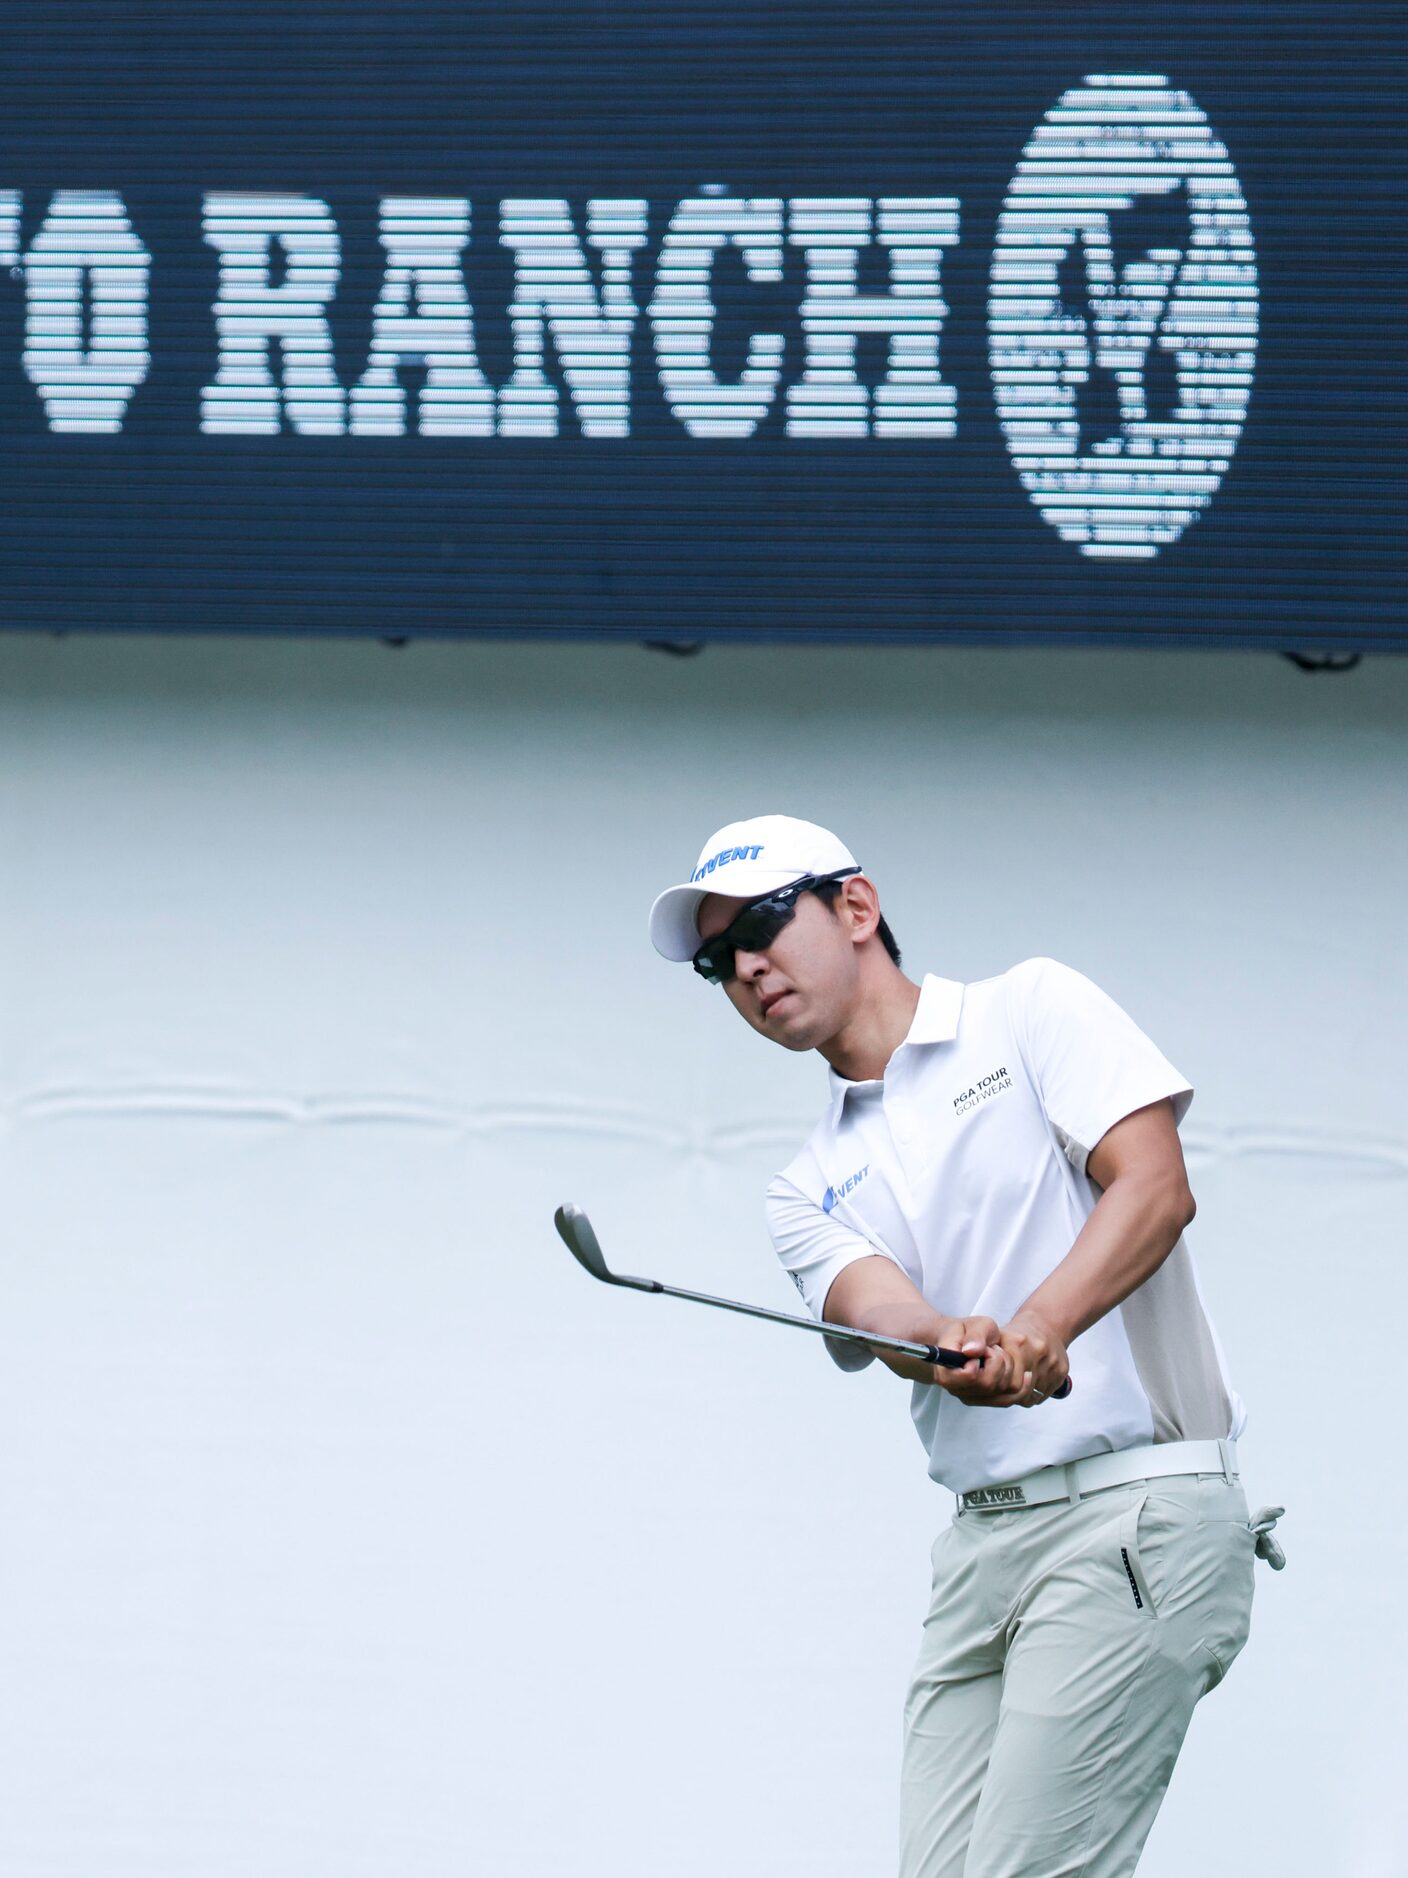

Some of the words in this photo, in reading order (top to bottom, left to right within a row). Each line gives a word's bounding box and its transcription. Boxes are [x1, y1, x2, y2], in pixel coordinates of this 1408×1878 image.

[200, 188, 961, 438] RANCH
[952, 1087, 976, 1108] PGA
[976, 1066, 1008, 1091] TOUR
[955, 1077, 1014, 1117] GOLFWEAR
